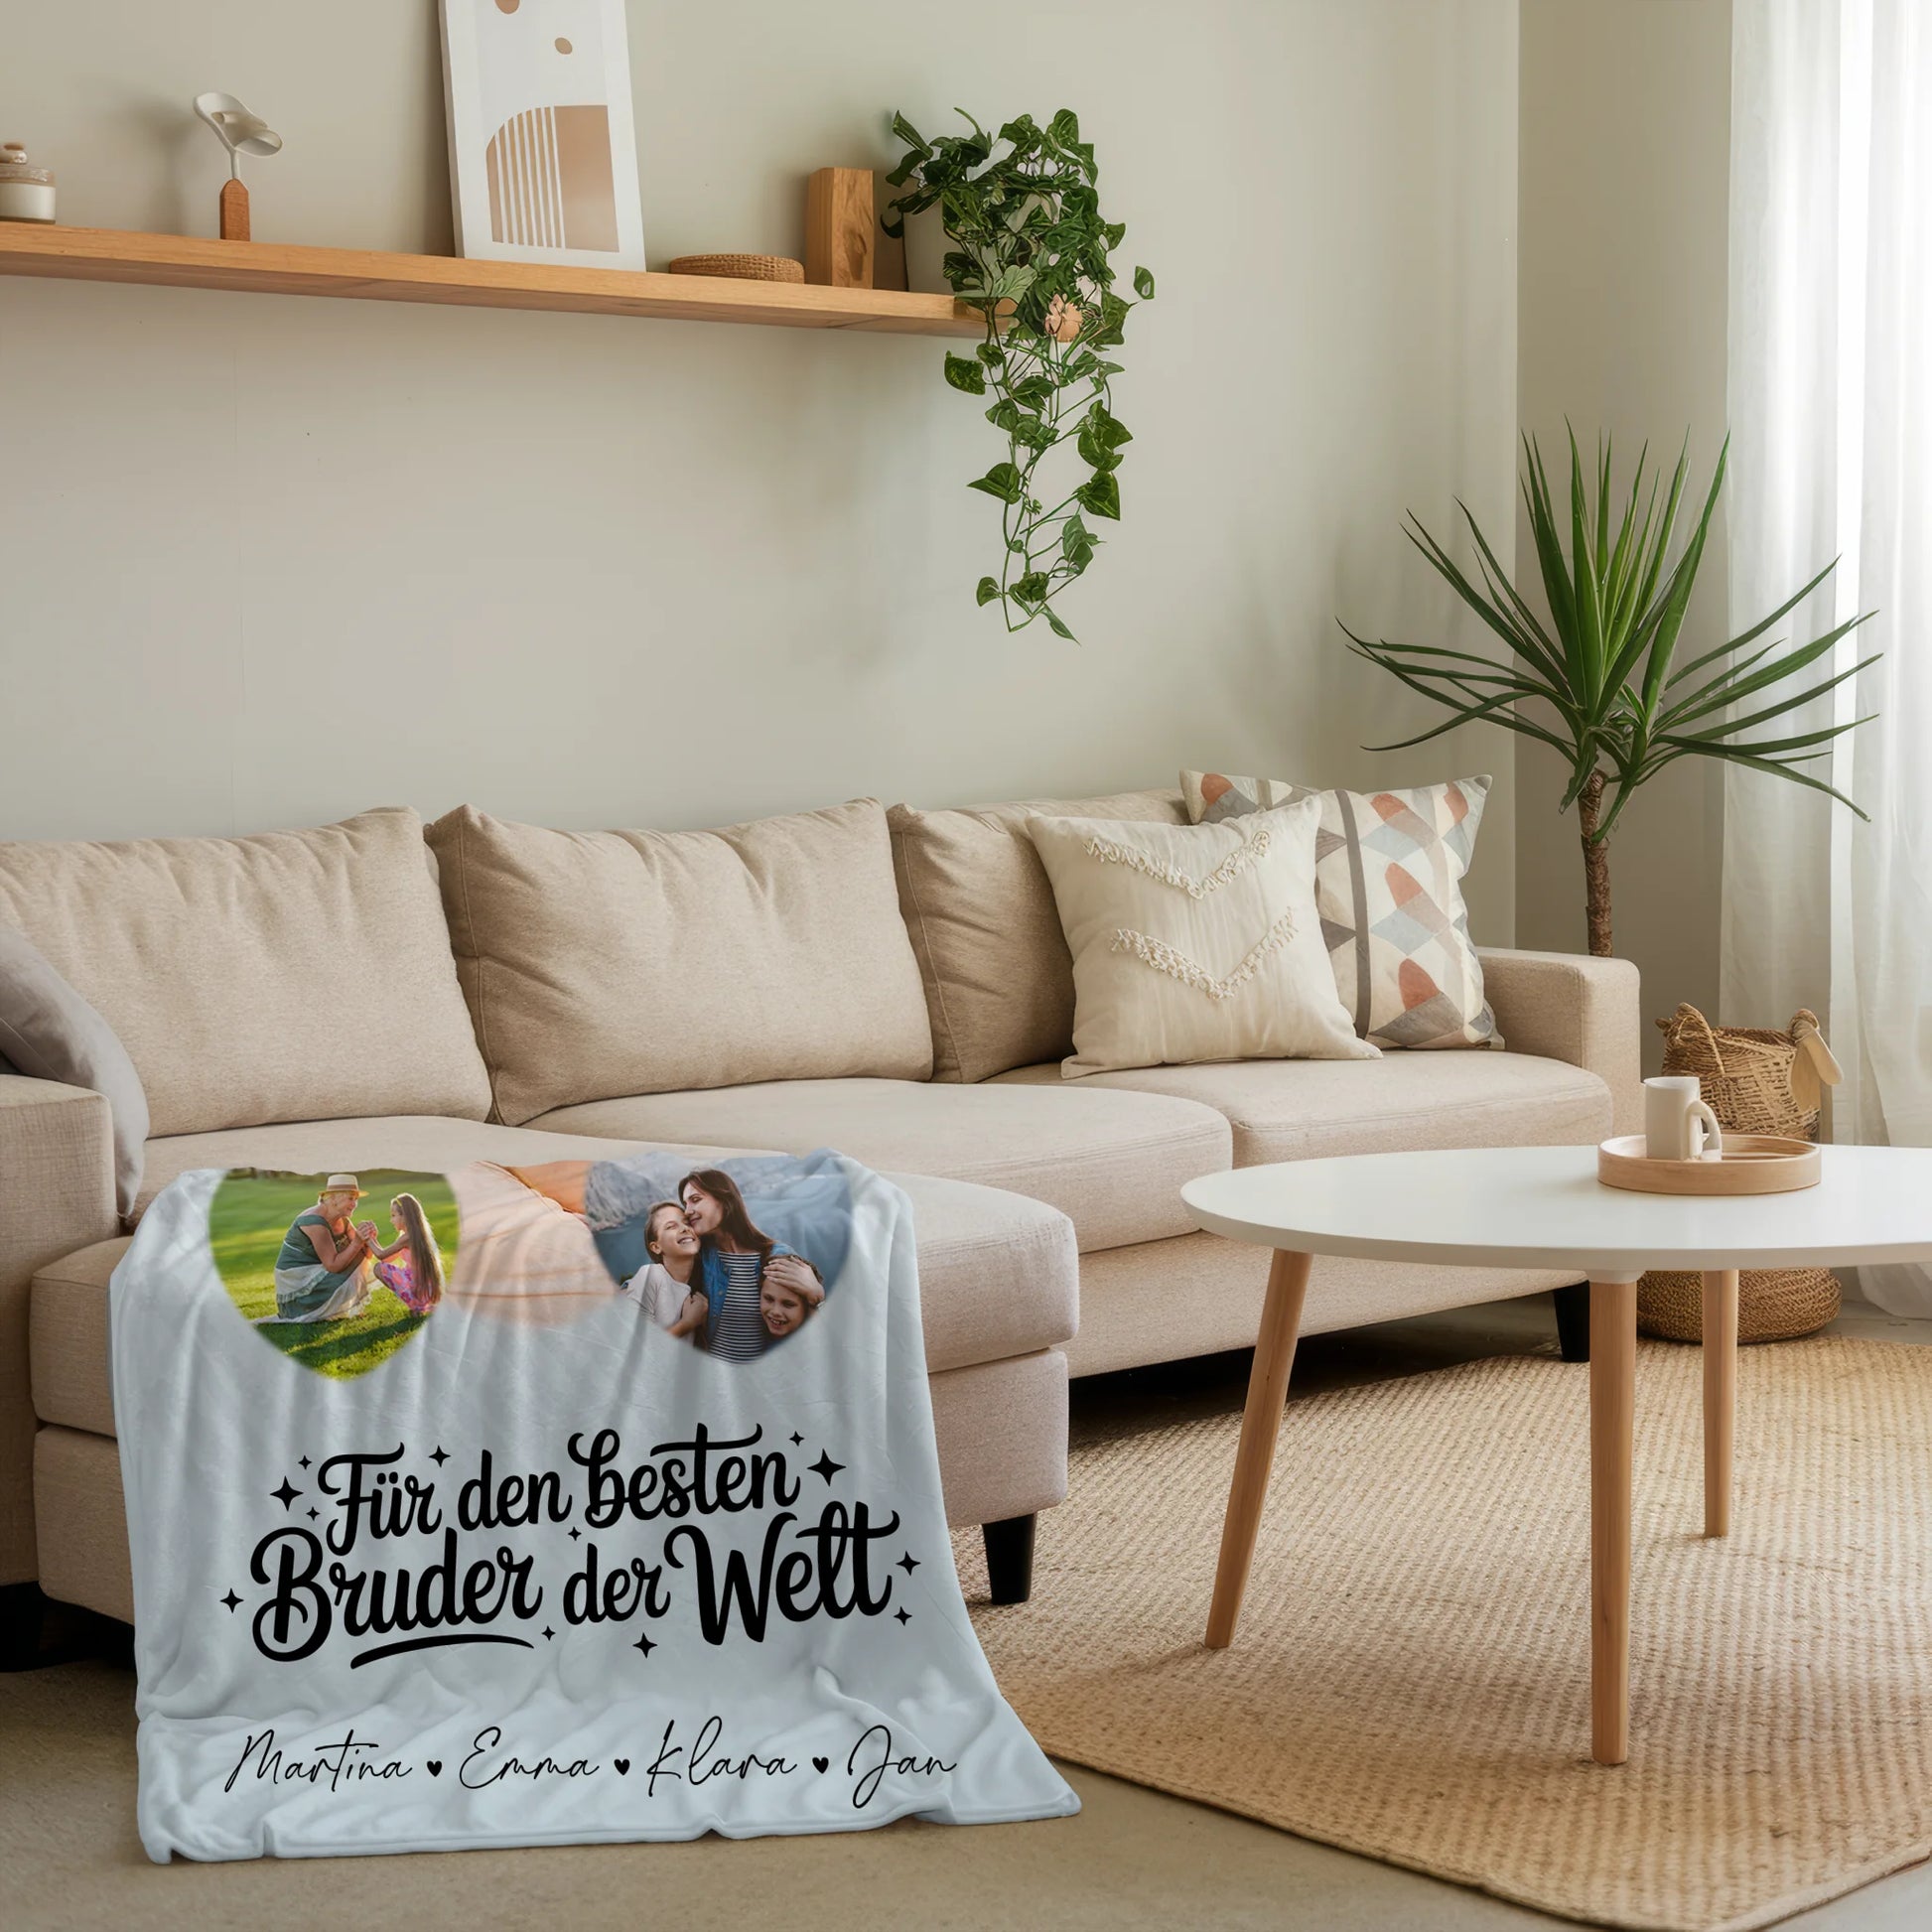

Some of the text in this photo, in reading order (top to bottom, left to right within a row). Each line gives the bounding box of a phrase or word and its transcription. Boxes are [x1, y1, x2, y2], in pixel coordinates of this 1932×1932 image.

[317, 1422, 801, 1557] Für den besten
[249, 1500, 900, 1663] Bruder der Welt
[223, 1715, 959, 1809] Martina Emma Klara Jan
